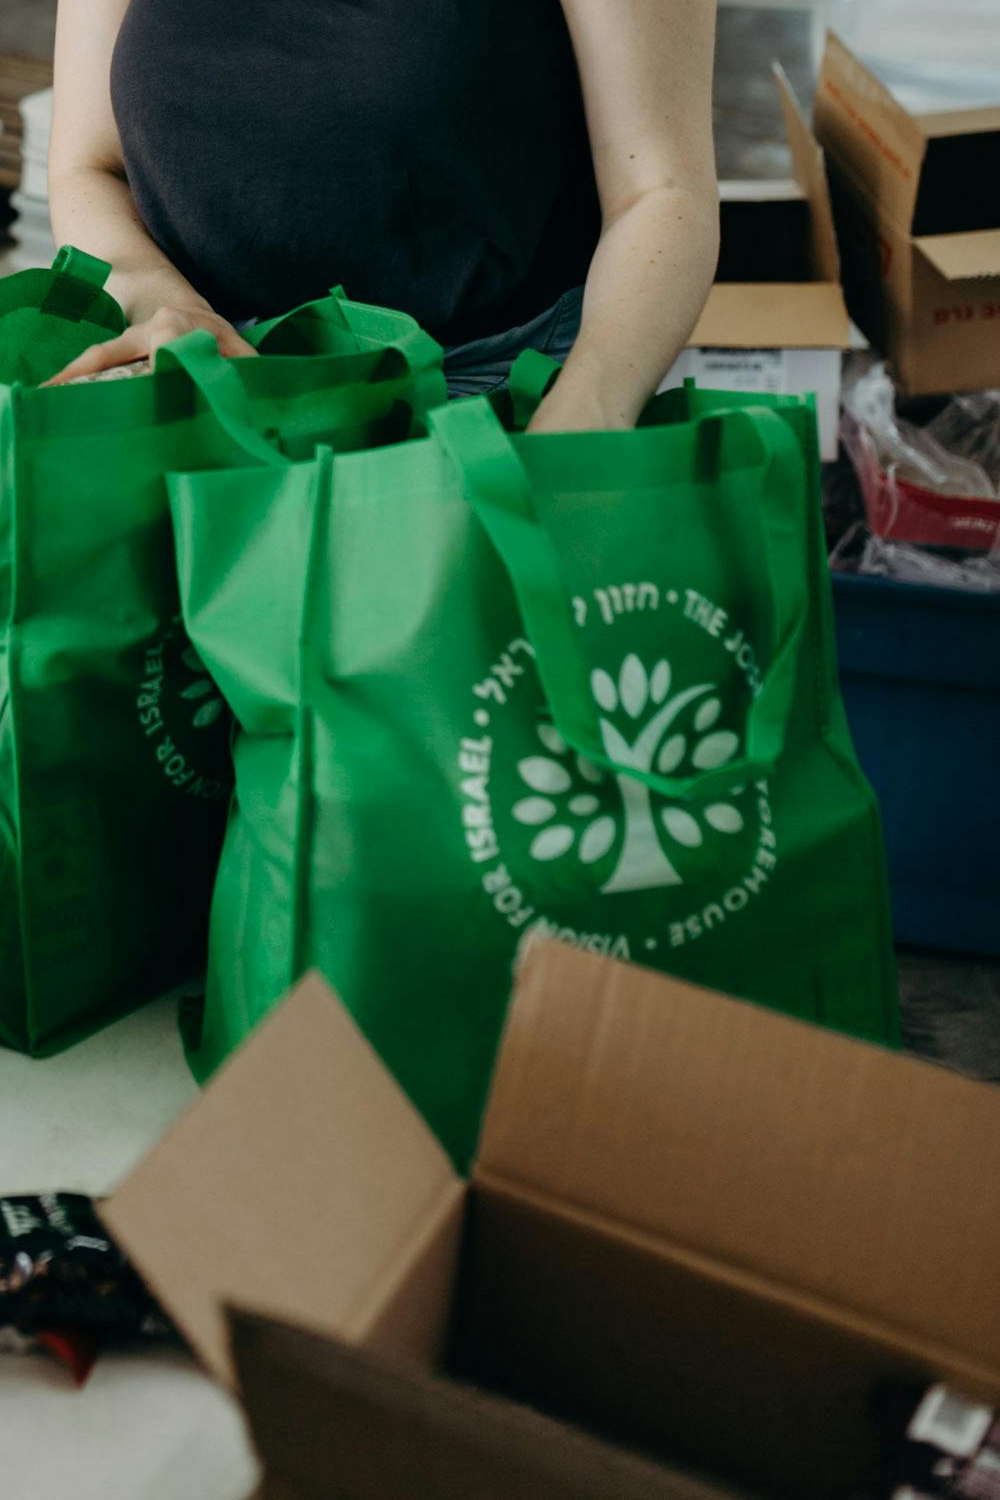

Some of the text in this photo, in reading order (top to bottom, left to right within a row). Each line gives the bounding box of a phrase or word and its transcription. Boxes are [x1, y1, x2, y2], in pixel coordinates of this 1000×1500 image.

[594, 581, 660, 624] חזון
[683, 589, 729, 638] THE
[138, 644, 195, 787] FOR ISRAEL
[458, 736, 502, 863] ISRAEL
[482, 863, 535, 928] FOR
[668, 779, 778, 948] TOREHOUSE
